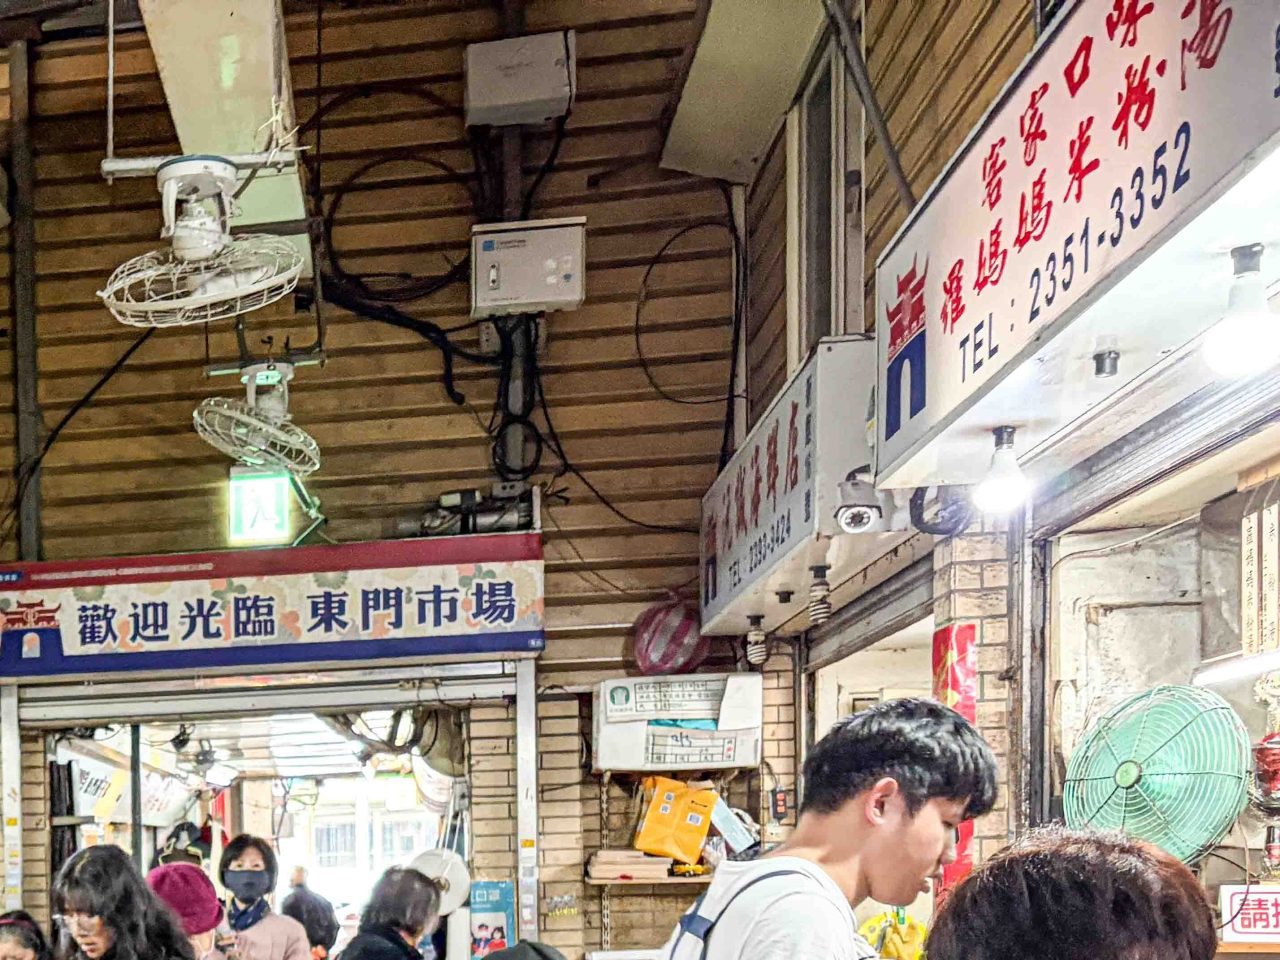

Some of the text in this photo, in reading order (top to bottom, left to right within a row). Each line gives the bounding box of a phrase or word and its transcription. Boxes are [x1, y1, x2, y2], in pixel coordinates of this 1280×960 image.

[1027, 120, 1192, 325] 2351-3352
[76, 580, 518, 647] 歡迎光臨 東門市場
